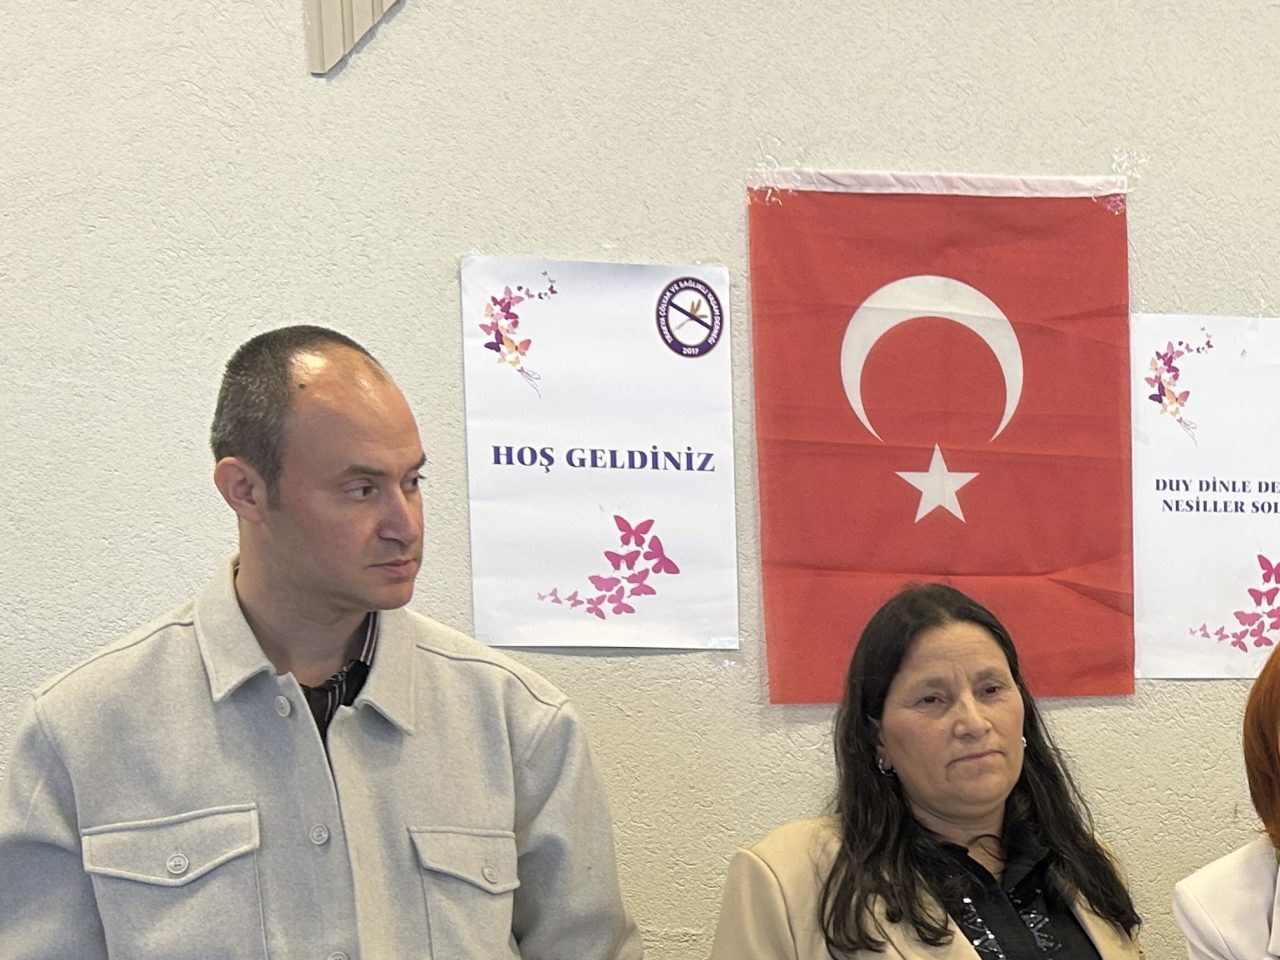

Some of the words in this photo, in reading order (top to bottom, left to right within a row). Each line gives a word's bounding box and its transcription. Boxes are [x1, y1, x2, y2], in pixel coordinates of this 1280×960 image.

[491, 445, 555, 473] HOŞ
[566, 445, 716, 472] GELDİNİZ
[1155, 478, 1193, 492] DUY
[1199, 476, 1252, 493] DİNLE
[1162, 496, 1246, 513] NESİLLER
